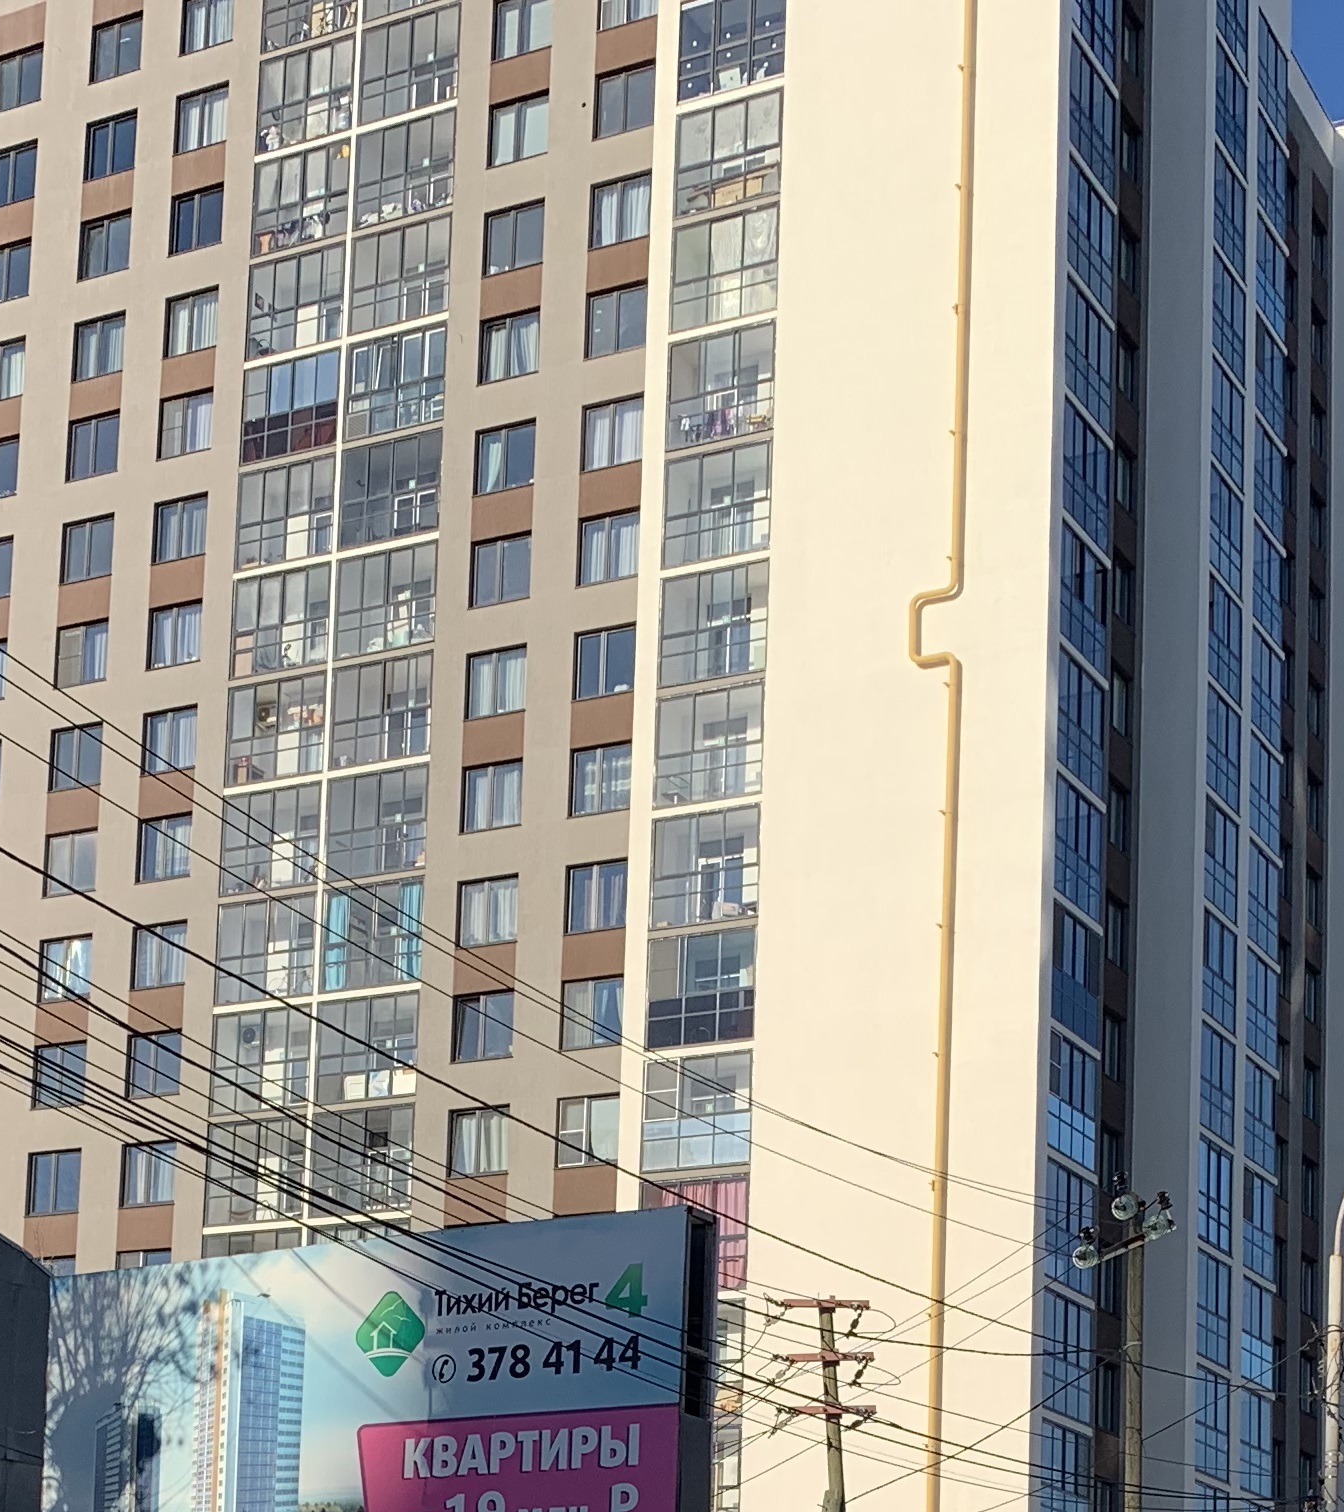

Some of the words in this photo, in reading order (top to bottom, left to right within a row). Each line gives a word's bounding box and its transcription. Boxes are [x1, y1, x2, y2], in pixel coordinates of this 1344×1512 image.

[434, 1287, 510, 1317] Тихий
[517, 1281, 600, 1314] Берег
[605, 1263, 648, 1319] 4
[466, 1343, 531, 1383] 378
[542, 1339, 582, 1376] 41
[593, 1335, 641, 1373] 44
[402, 1423, 641, 1479] КВАРТИРЫ
